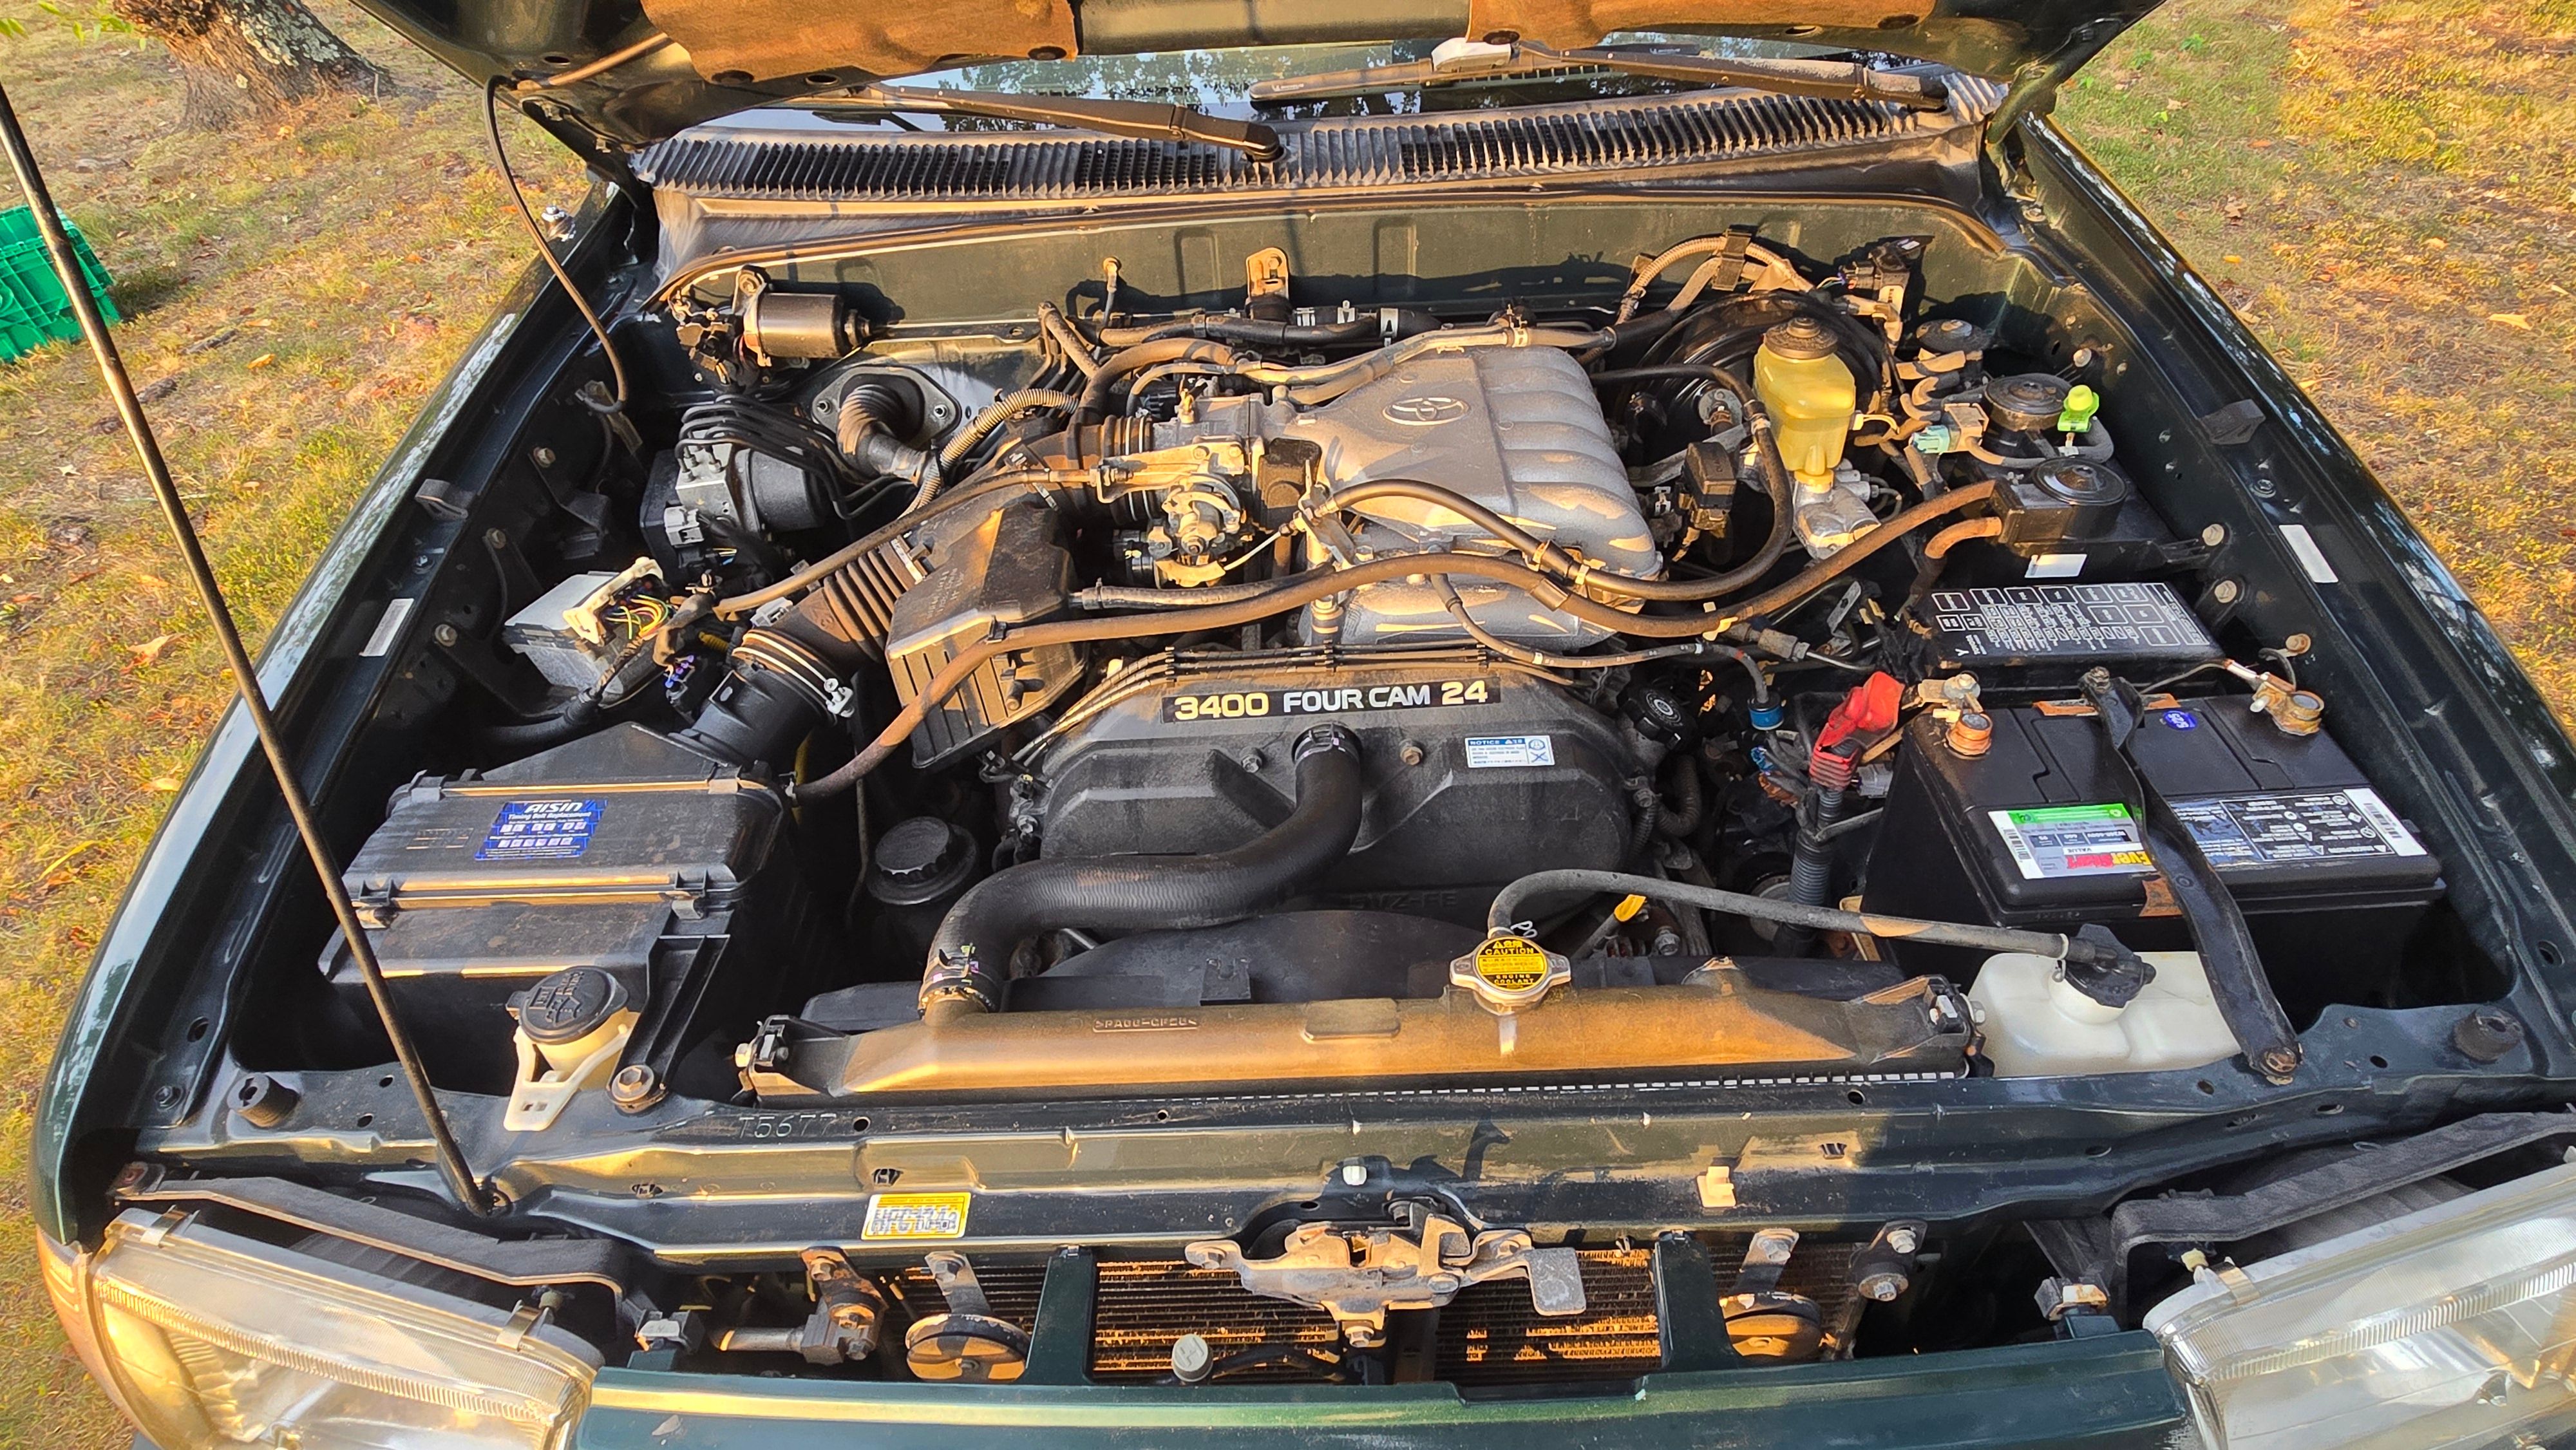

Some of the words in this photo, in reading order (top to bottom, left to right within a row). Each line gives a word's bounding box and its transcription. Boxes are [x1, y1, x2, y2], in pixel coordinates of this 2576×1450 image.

[1955, 648, 1969, 657] Y
[1965, 634, 1981, 655] TOYOTA
[1173, 692, 1269, 720] 3400
[1283, 688, 1362, 713] FOUR
[1369, 684, 1430, 708] CAM
[1441, 680, 1488, 704] 24
[525, 802, 583, 813] AISIN
[2066, 851, 2153, 869] EverStart
[739, 1113, 837, 1138] T5677
